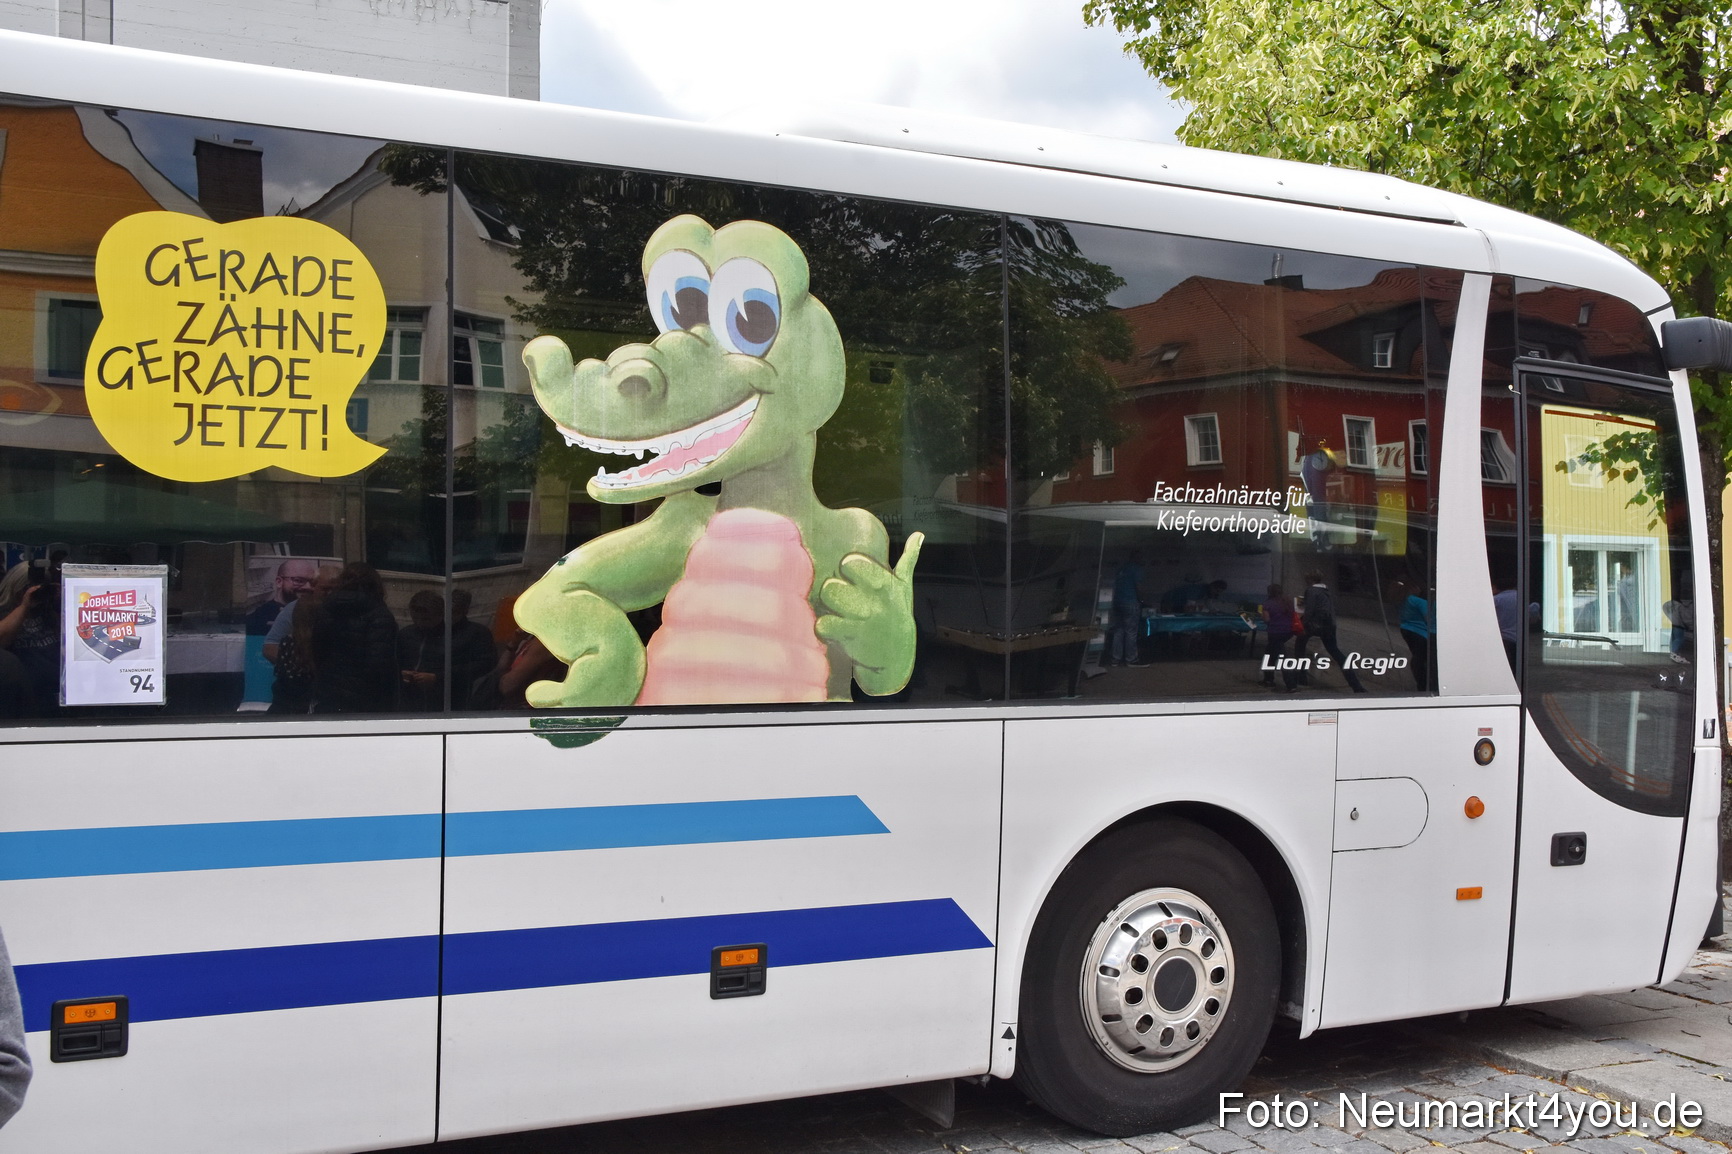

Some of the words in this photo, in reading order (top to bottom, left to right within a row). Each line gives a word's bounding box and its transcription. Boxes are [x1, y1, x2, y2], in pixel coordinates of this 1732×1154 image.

[145, 237, 355, 301] GERADE
[173, 292, 365, 358] ZÄHNE,
[97, 338, 313, 400] GERADE
[173, 402, 329, 451] JETZT!
[1153, 480, 1282, 506] Fachzahnärzte
[1284, 485, 1310, 512] für
[1156, 509, 1306, 540] Kieferorthopädie
[85, 592, 133, 608] JOBMEILE
[81, 609, 137, 624] NEUMARKT
[110, 625, 133, 639] 2018
[1260, 652, 1331, 671] Lion's
[1342, 651, 1408, 676] Regio
[129, 674, 155, 694] 94
